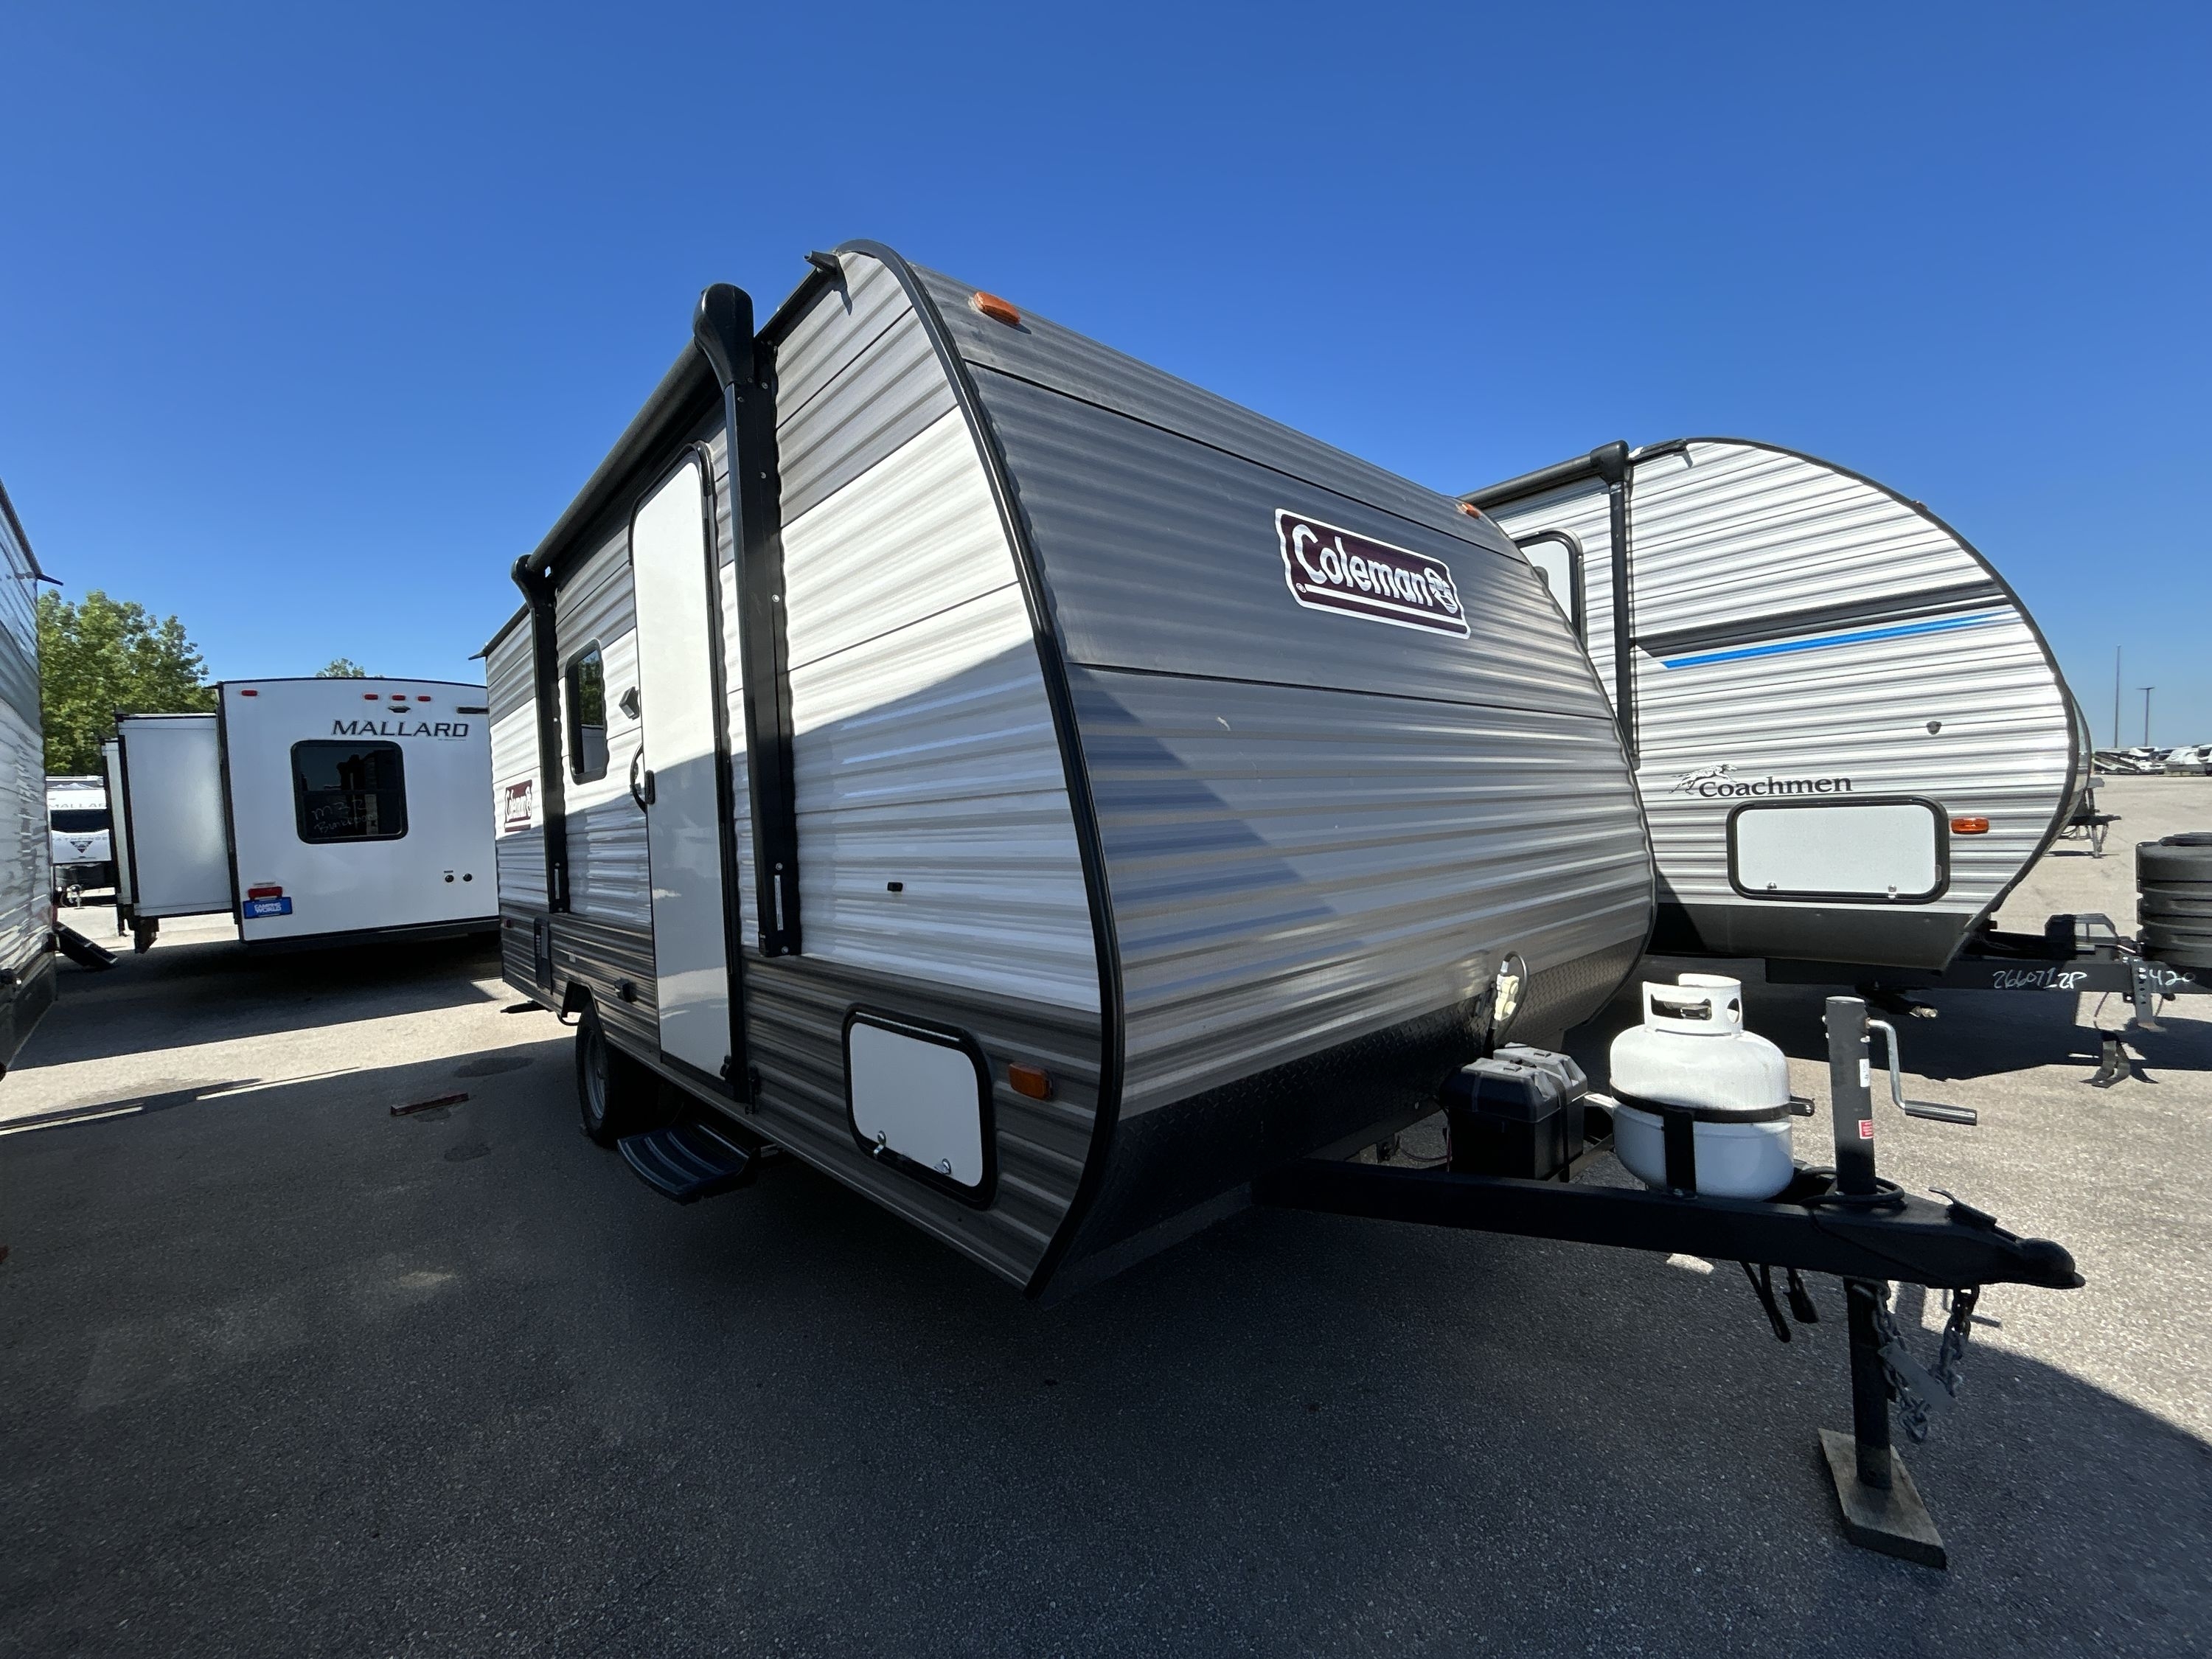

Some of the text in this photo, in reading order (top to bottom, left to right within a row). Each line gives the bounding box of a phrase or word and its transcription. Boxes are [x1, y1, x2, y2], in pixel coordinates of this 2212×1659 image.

[1292, 524, 1433, 607] Coleman
[331, 720, 469, 737] MALLARD
[1699, 776, 1853, 798] Coachmen
